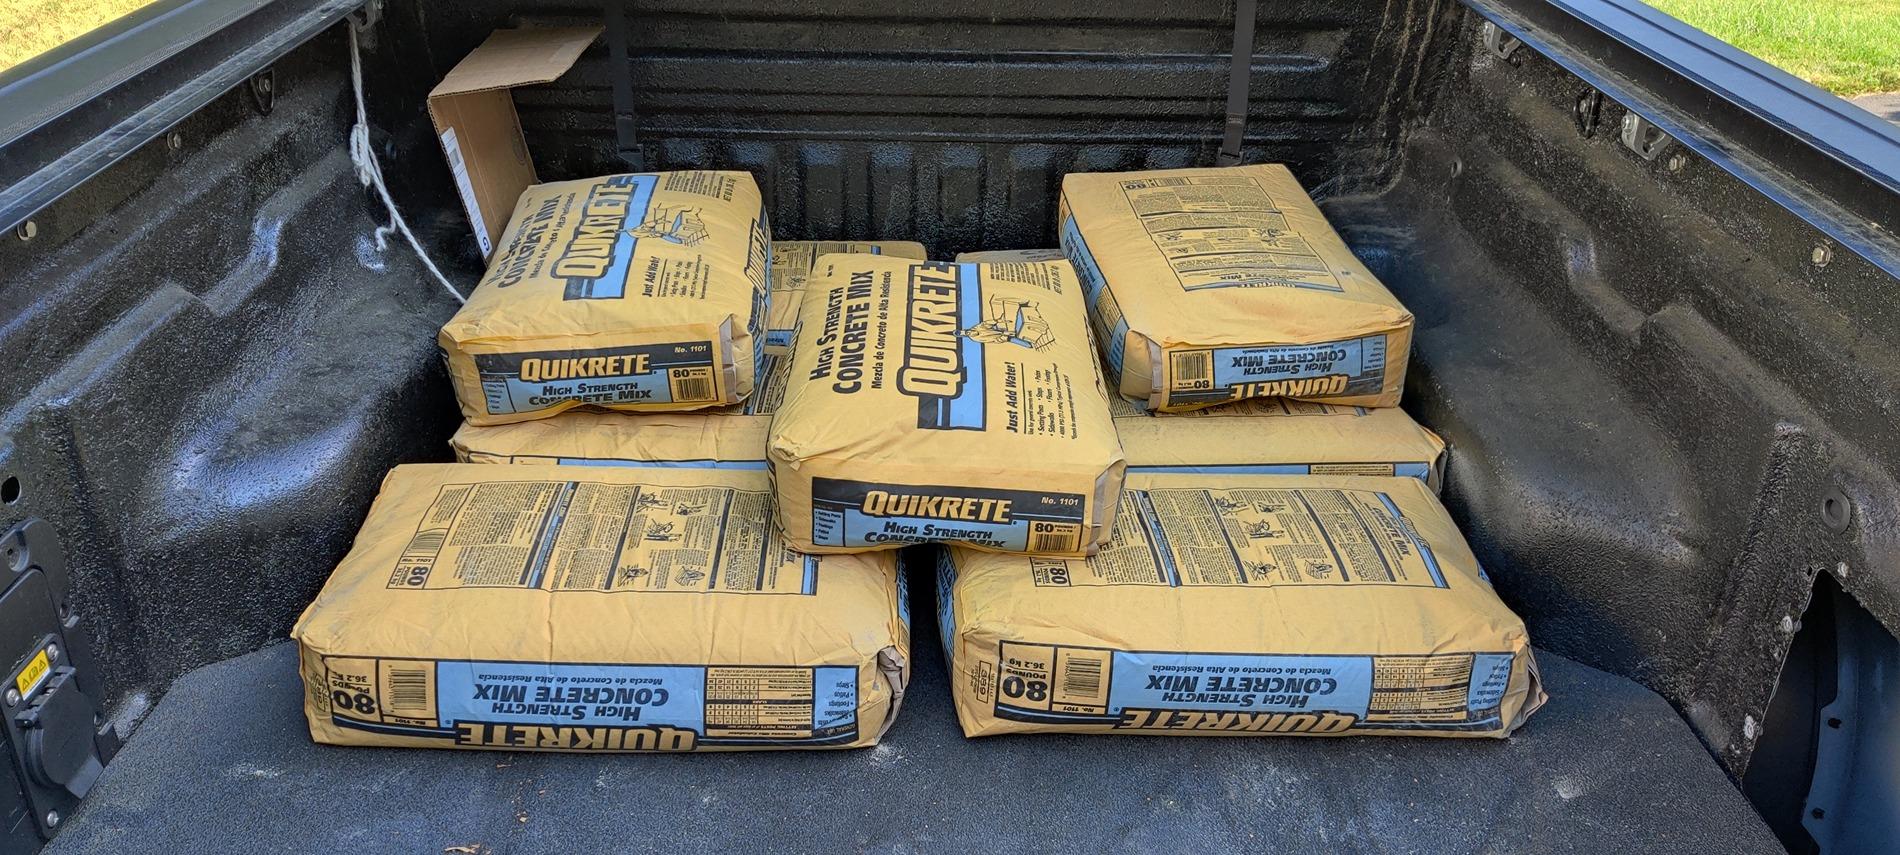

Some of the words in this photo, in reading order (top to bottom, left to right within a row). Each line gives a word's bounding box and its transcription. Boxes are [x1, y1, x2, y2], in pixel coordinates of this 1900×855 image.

[555, 184, 635, 277] QUIKRETE
[645, 269, 657, 283] Add
[641, 281, 655, 297] Just
[846, 270, 874, 300] MIX
[879, 298, 889, 310] Alta
[816, 287, 844, 346] STRENGTH
[877, 310, 888, 320] de
[875, 321, 887, 350] Concreto
[902, 264, 962, 397] QUIKRETE
[832, 302, 870, 394] CONCRETE
[873, 349, 885, 360] de
[520, 353, 650, 382] QUIKRETE
[674, 346, 688, 354] No.
[690, 345, 707, 353] 1101
[809, 345, 834, 380] HIGH
[1231, 355, 1263, 368] MIX
[1269, 350, 1347, 364] CONCRETE
[673, 369, 690, 378] 80
[1243, 364, 1301, 376] STRENGTH
[1304, 362, 1333, 372] HIGH
[871, 362, 884, 389] Mezcla
[1004, 361, 1016, 388] Water!
[542, 385, 573, 396] HIGH
[577, 382, 638, 394] STRENGTH
[1194, 380, 1210, 389] 80
[1230, 374, 1349, 401] QUIKRETE
[618, 389, 652, 400] MIX
[1005, 389, 1017, 409] Add
[1006, 410, 1018, 433] Just
[862, 490, 1013, 522] QUIKRETE
[1041, 496, 1056, 505] No.
[1059, 498, 1079, 506] 1101
[883, 521, 918, 535] HIGH
[922, 524, 993, 539] STRENGTH
[1034, 523, 1054, 532] 80
[406, 566, 429, 586] 80
[1049, 567, 1068, 585] 80
[1009, 658, 1023, 668] kg
[1024, 661, 1045, 670] 36.2
[1152, 665, 1204, 673] Resistencia
[1228, 666, 1240, 674] de
[1005, 668, 1047, 680] POUNDS
[1242, 666, 1283, 675] Concreto
[1285, 667, 1297, 675] de
[1299, 667, 1332, 675] Mezcla
[346, 674, 367, 683] 36.2
[478, 673, 531, 683] Resistencia
[534, 675, 553, 683] Alta
[556, 675, 568, 683] de
[571, 675, 613, 684] Concreto
[614, 676, 627, 684] de
[629, 676, 664, 685] Mezcla
[835, 680, 850, 689] Steps
[1145, 674, 1199, 691] MIX
[473, 683, 527, 702] MIX
[1002, 676, 1048, 702] 80
[1205, 676, 1337, 695] CONCRETE
[332, 689, 376, 716] 80
[535, 685, 670, 707] CONCRETE
[1162, 692, 1257, 707] STRENGTH
[1263, 693, 1309, 707] HIGH
[491, 702, 587, 720] STRENGTH
[594, 706, 642, 721] HIGH
[1119, 710, 1356, 733] QUIKRETE
[455, 722, 697, 751] QUIKRETE
